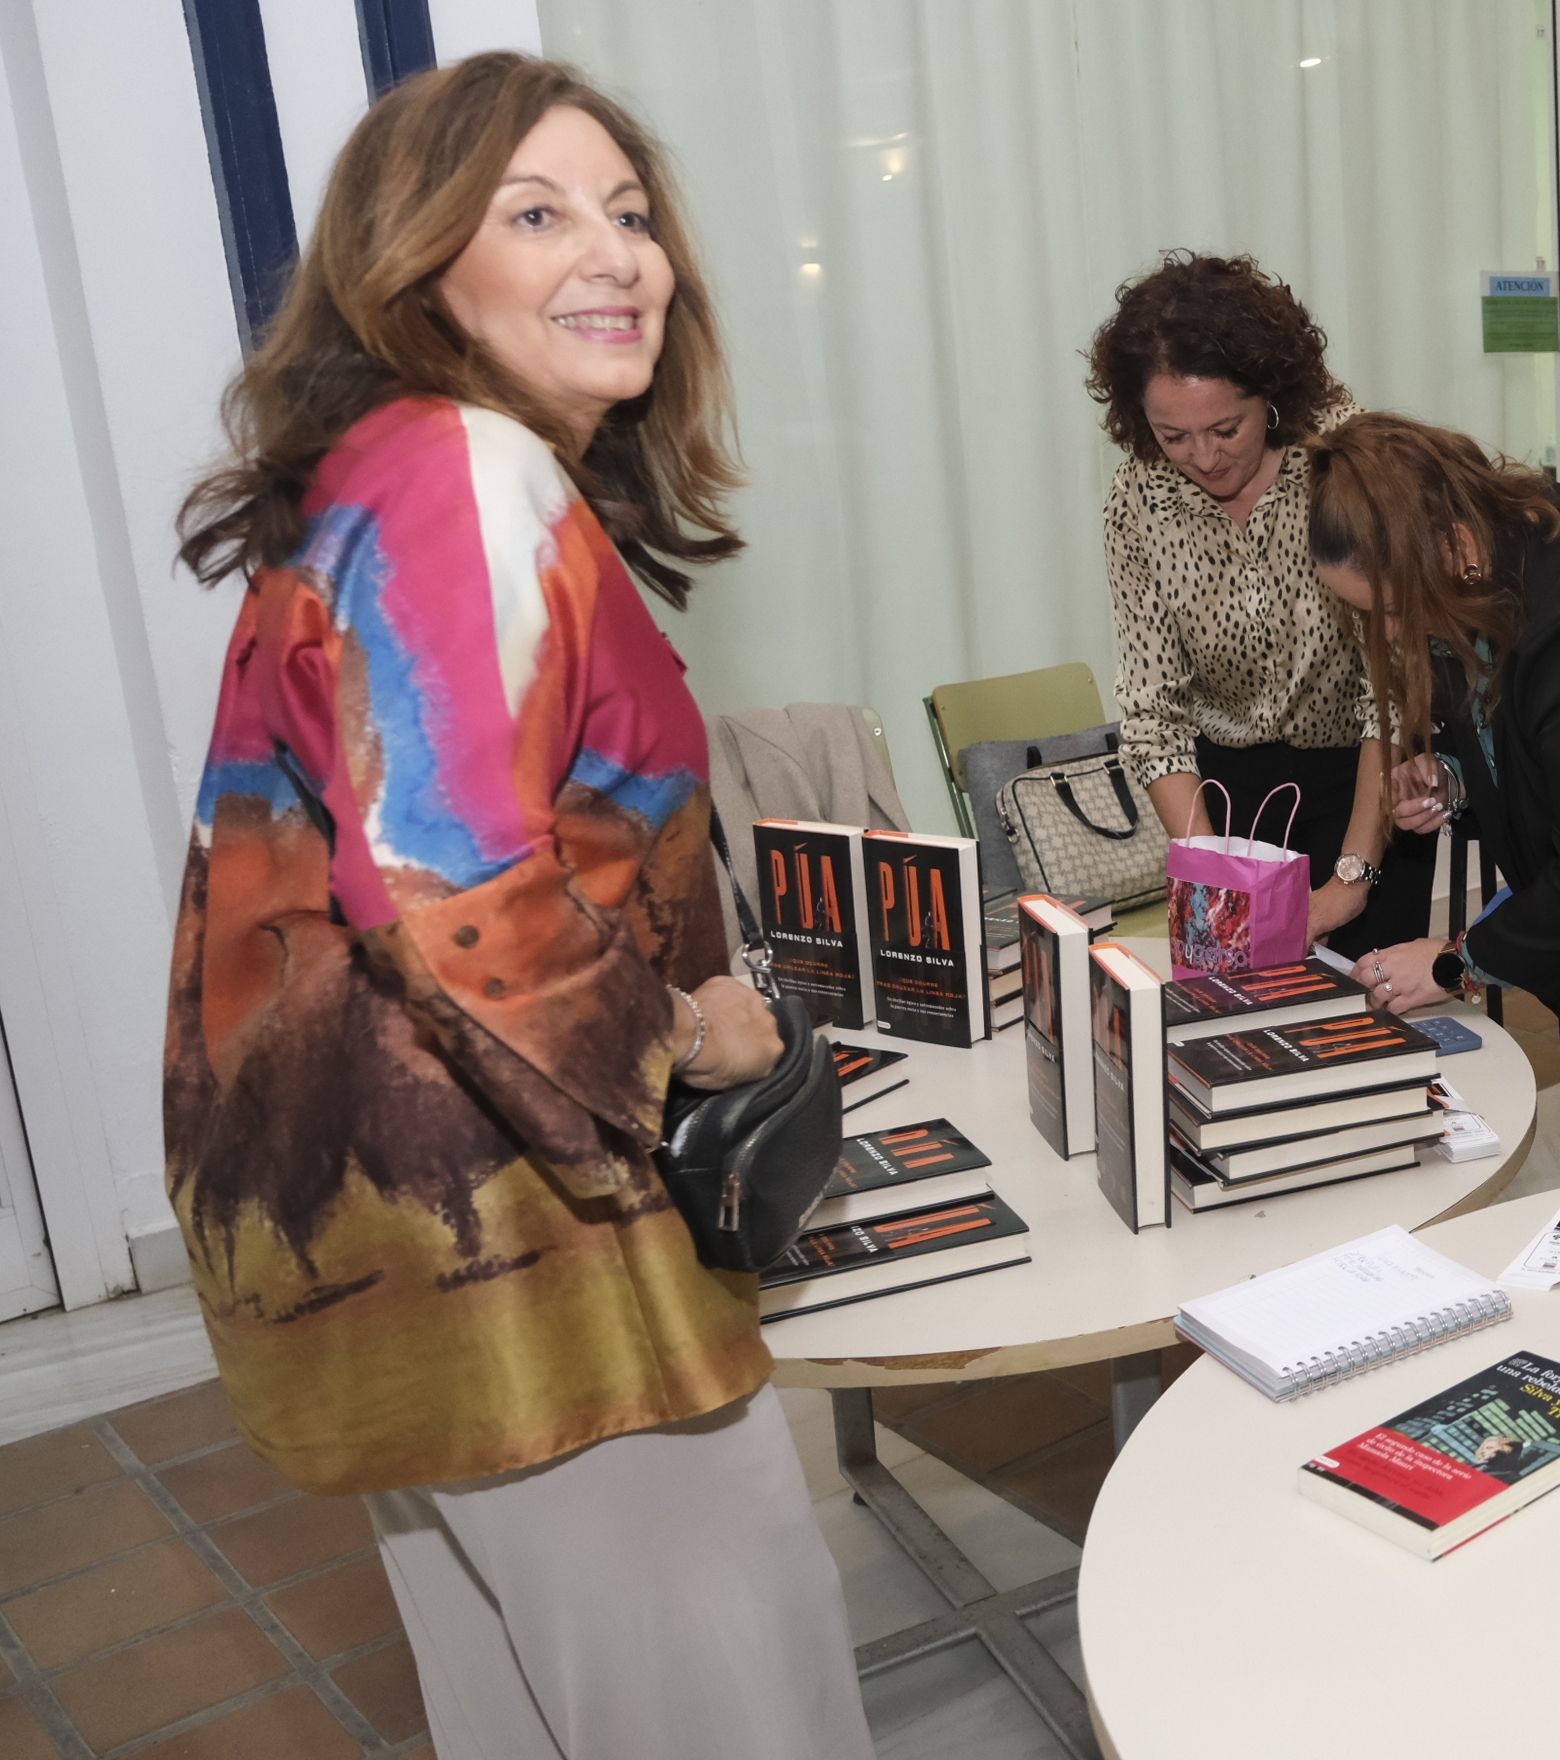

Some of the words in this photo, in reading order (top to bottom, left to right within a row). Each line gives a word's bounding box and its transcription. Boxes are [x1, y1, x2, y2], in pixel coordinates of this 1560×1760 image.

[1496, 278, 1544, 291] ATENCIÓN
[770, 842, 842, 934] PÚA
[879, 854, 950, 951] PÚA
[770, 930, 812, 944] LORENZO
[815, 937, 844, 948] SILVA
[880, 949, 922, 963] LORENZO
[925, 956, 955, 967] SILVA
[1208, 976, 1237, 994] LORENZO
[1234, 993, 1253, 1006] SILVA
[1227, 964, 1337, 1002] PÚA
[1263, 1029, 1295, 1050] LORENZO
[1290, 1047, 1310, 1062] SILVA
[1284, 1016, 1407, 1059] PÚA
[857, 1138, 881, 1160] LORENZO
[879, 1159, 899, 1177] SILVA
[873, 1202, 997, 1250] ÚA
[860, 1237, 880, 1254] SILVA
[1496, 1364, 1522, 1378] una
[1521, 1362, 1541, 1374] La
[1520, 1383, 1553, 1402] Silva
